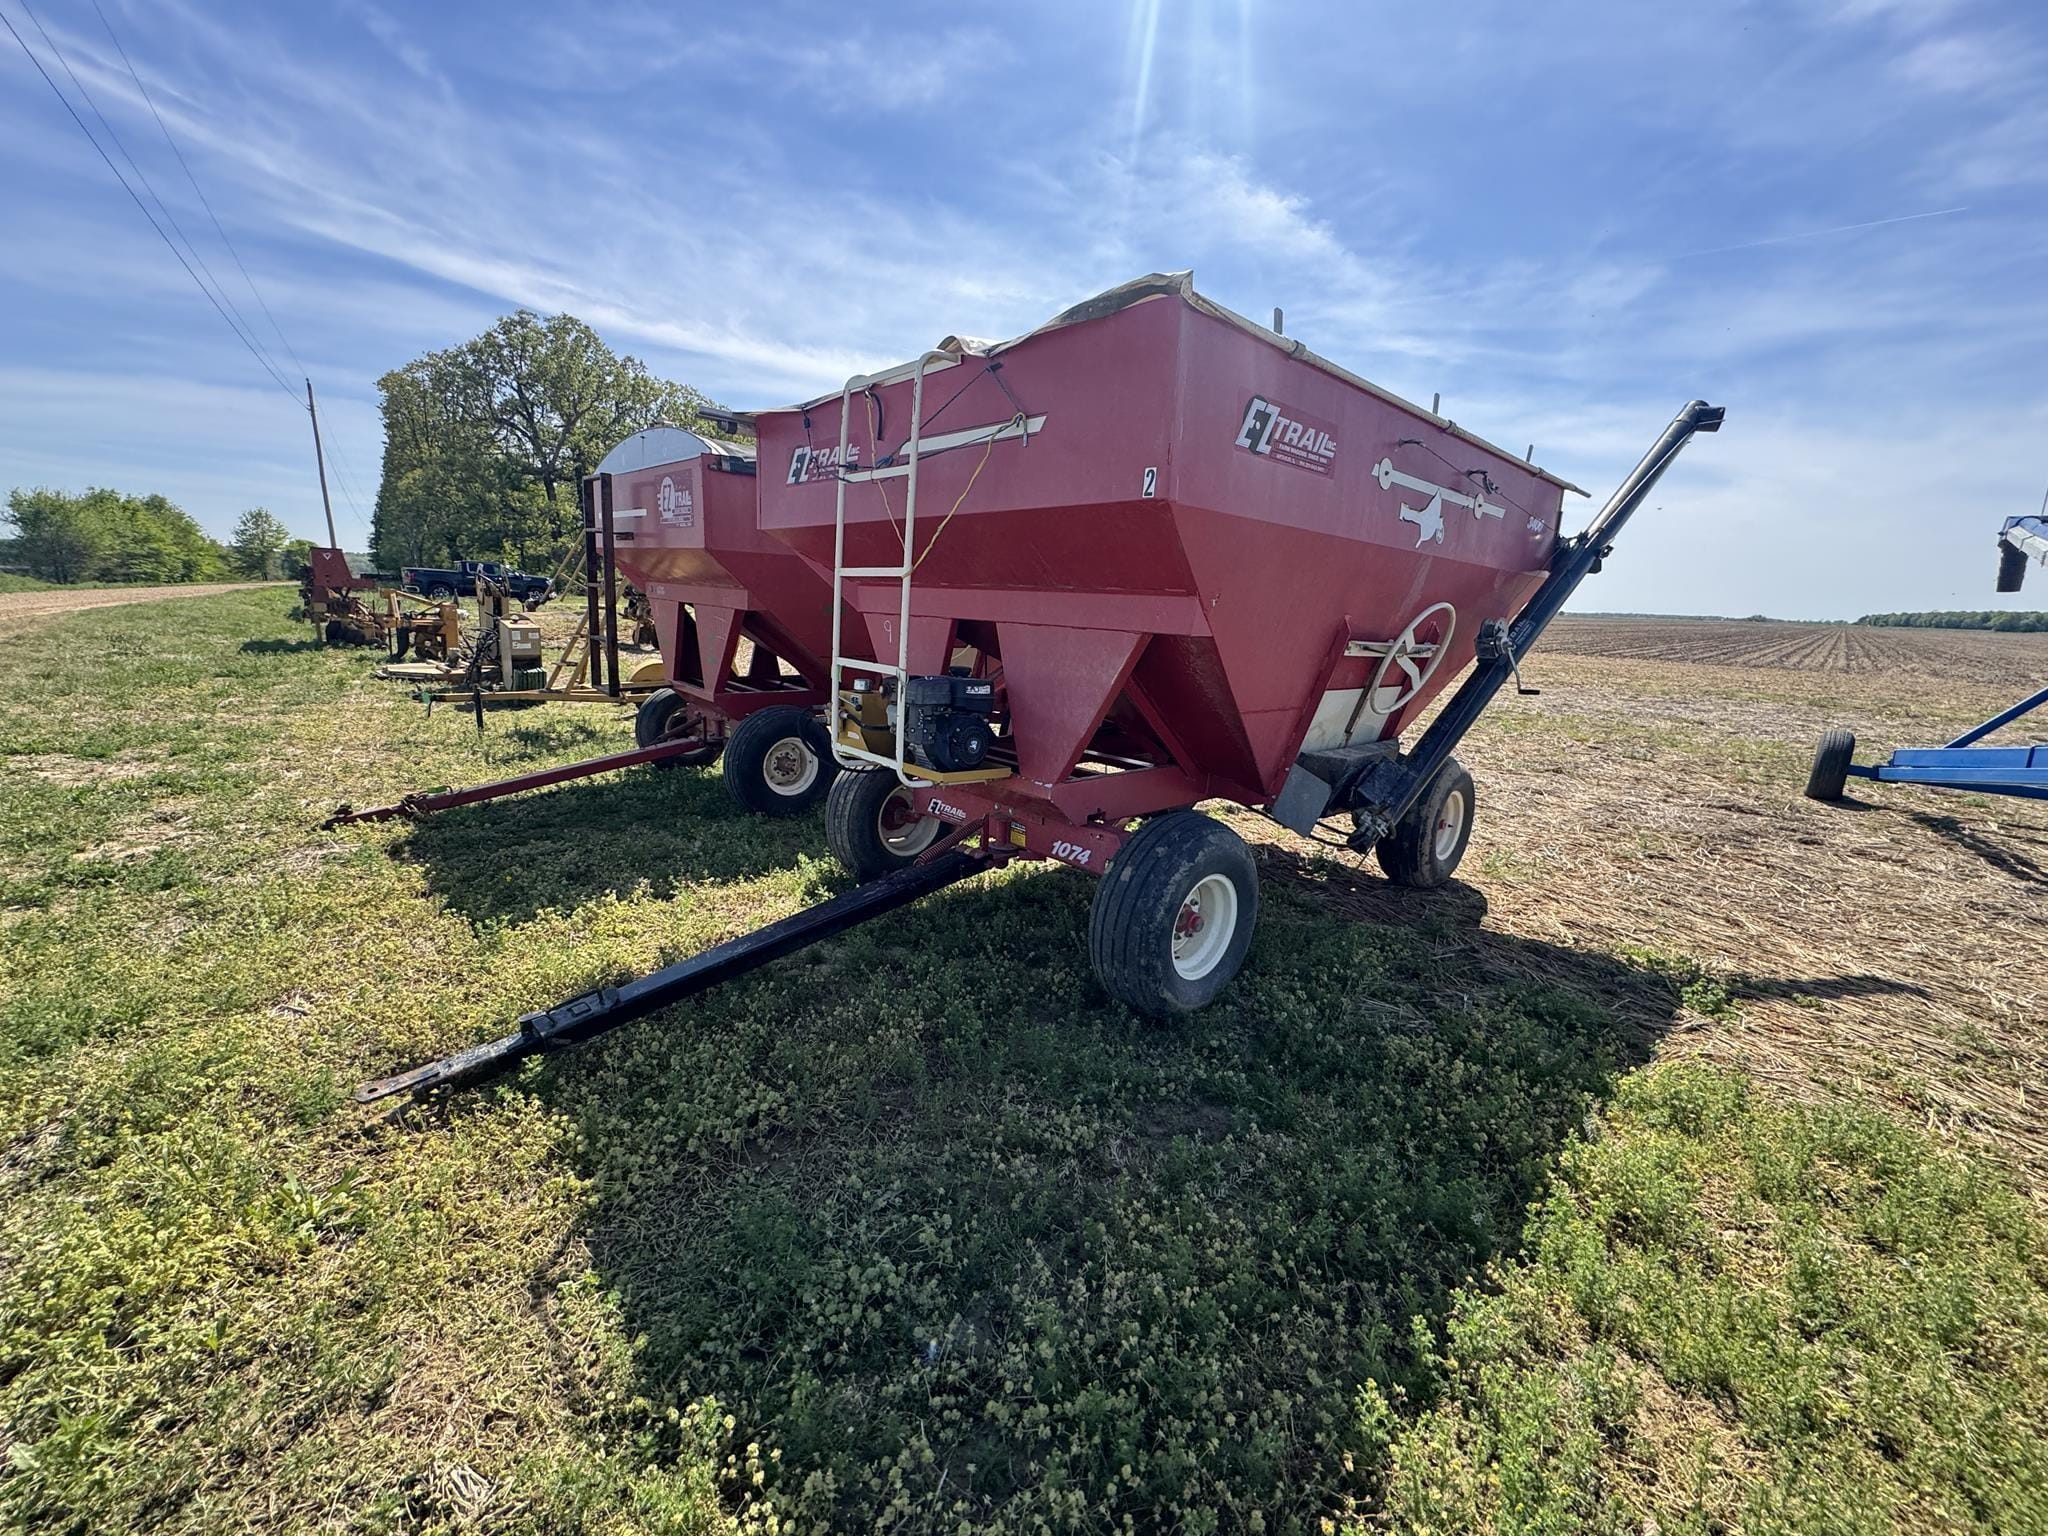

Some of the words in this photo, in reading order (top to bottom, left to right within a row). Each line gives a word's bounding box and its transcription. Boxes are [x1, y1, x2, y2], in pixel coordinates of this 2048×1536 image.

[1273, 416, 1335, 458] TRAIL
[809, 443, 859, 469] TRAL
[1144, 469, 1155, 496] 2
[940, 803, 966, 818] TRAIL
[1051, 840, 1091, 865] 1074
